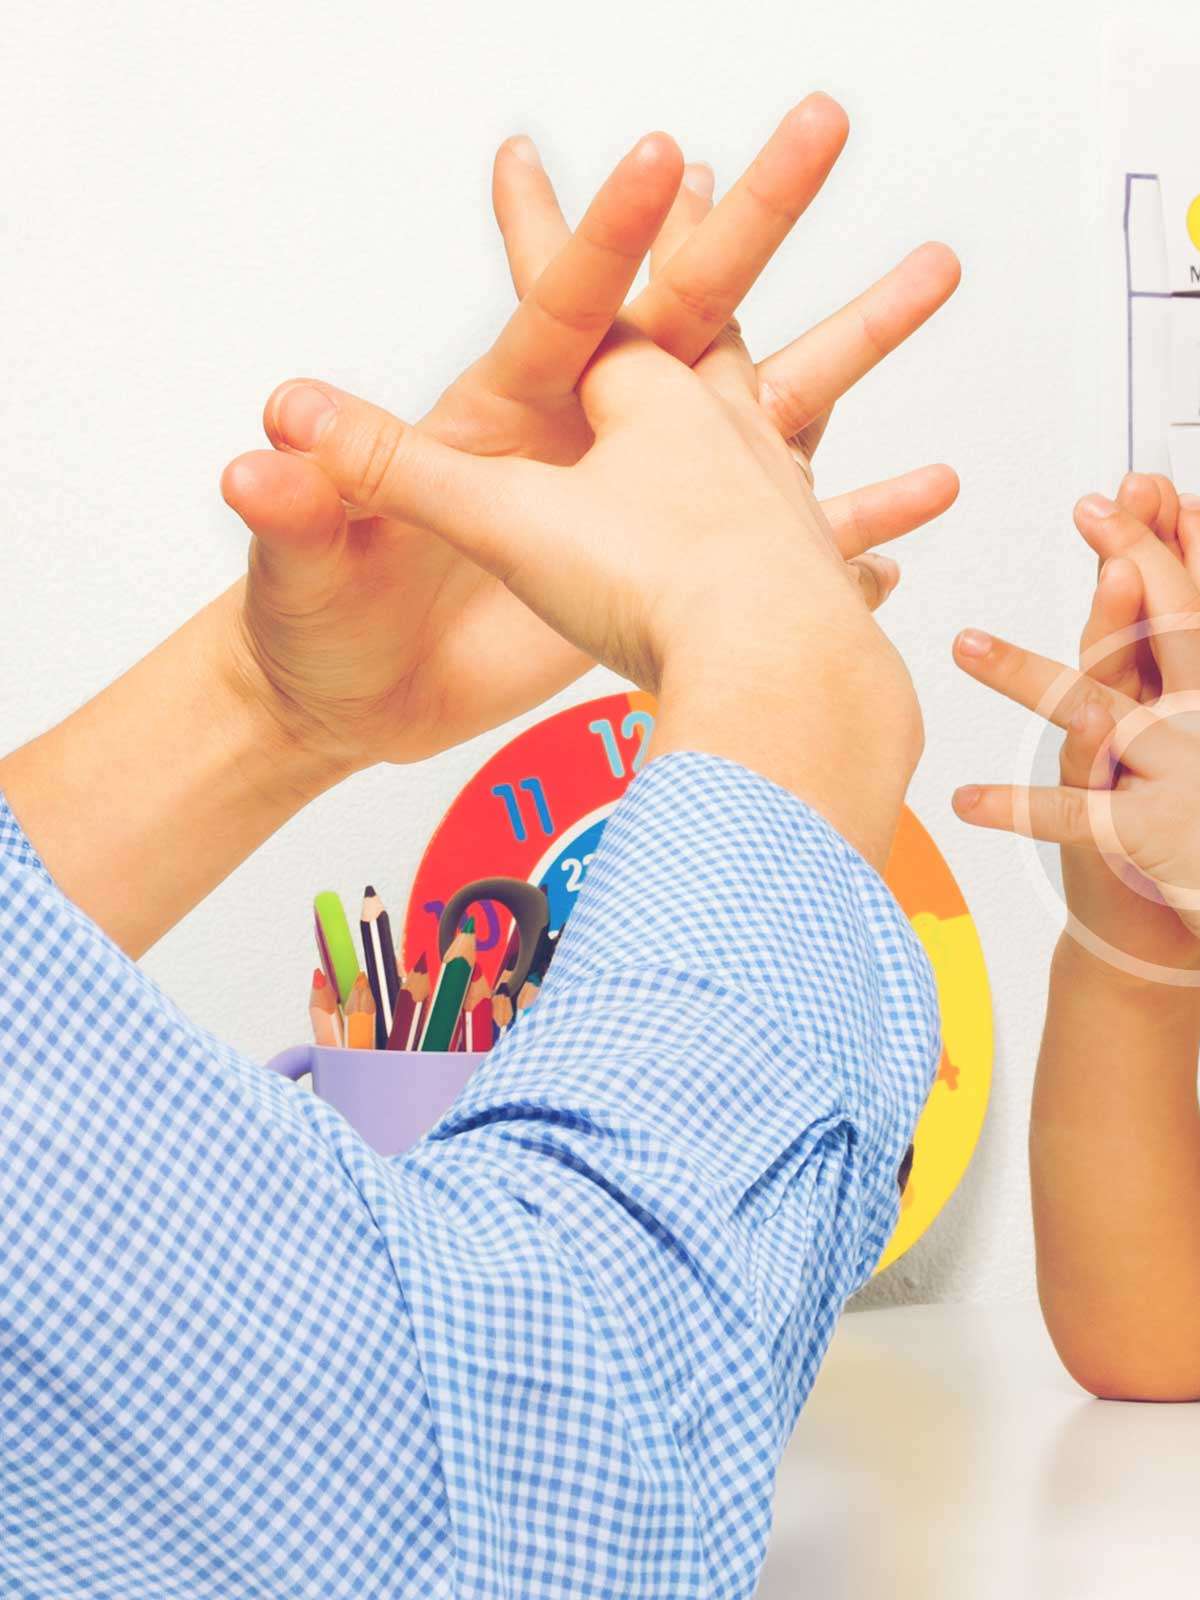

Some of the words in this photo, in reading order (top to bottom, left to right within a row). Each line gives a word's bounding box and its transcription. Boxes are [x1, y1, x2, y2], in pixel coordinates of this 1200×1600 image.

[588, 710, 656, 778] 12
[490, 776, 555, 843] 11
[560, 853, 595, 893] 2
